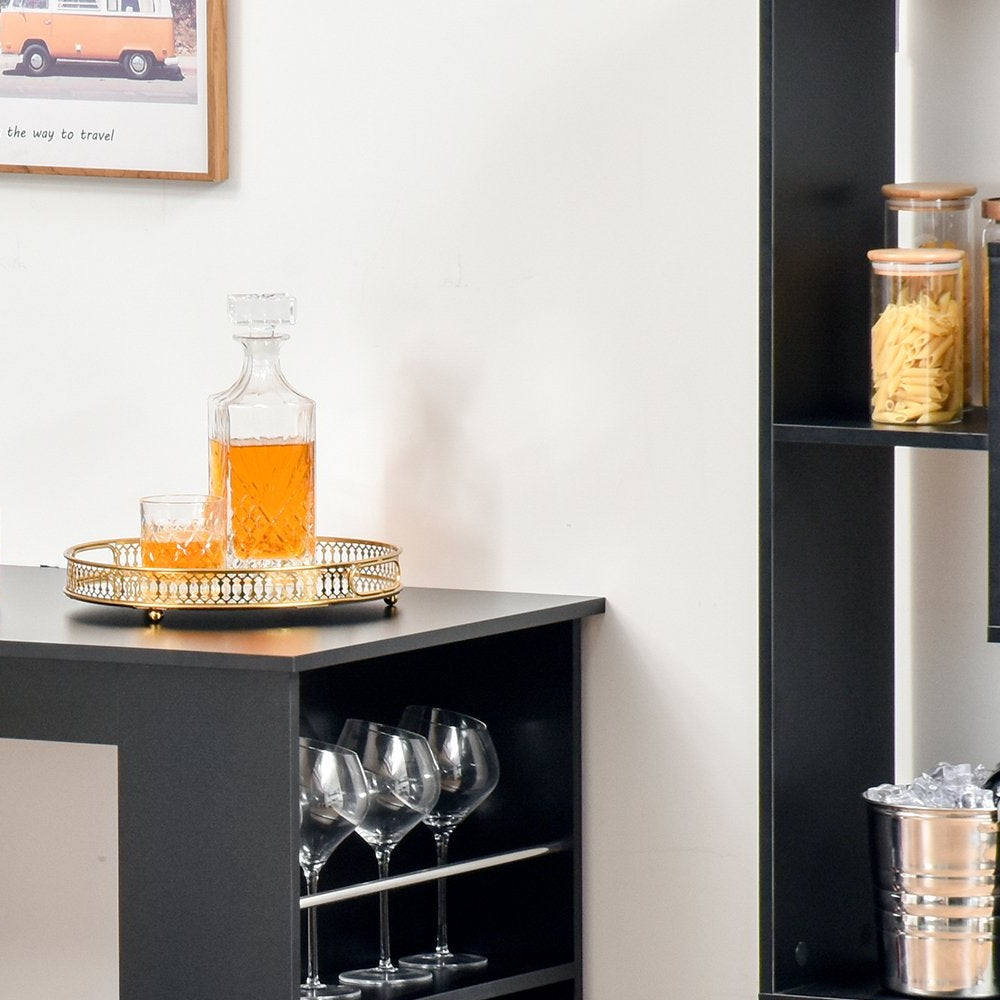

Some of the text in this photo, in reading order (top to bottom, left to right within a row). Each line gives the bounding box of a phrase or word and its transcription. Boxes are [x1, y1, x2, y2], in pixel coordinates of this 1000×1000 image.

[7, 125, 26, 138] the
[32, 128, 55, 142] way
[61, 128, 74, 140] to
[80, 128, 115, 141] travel
